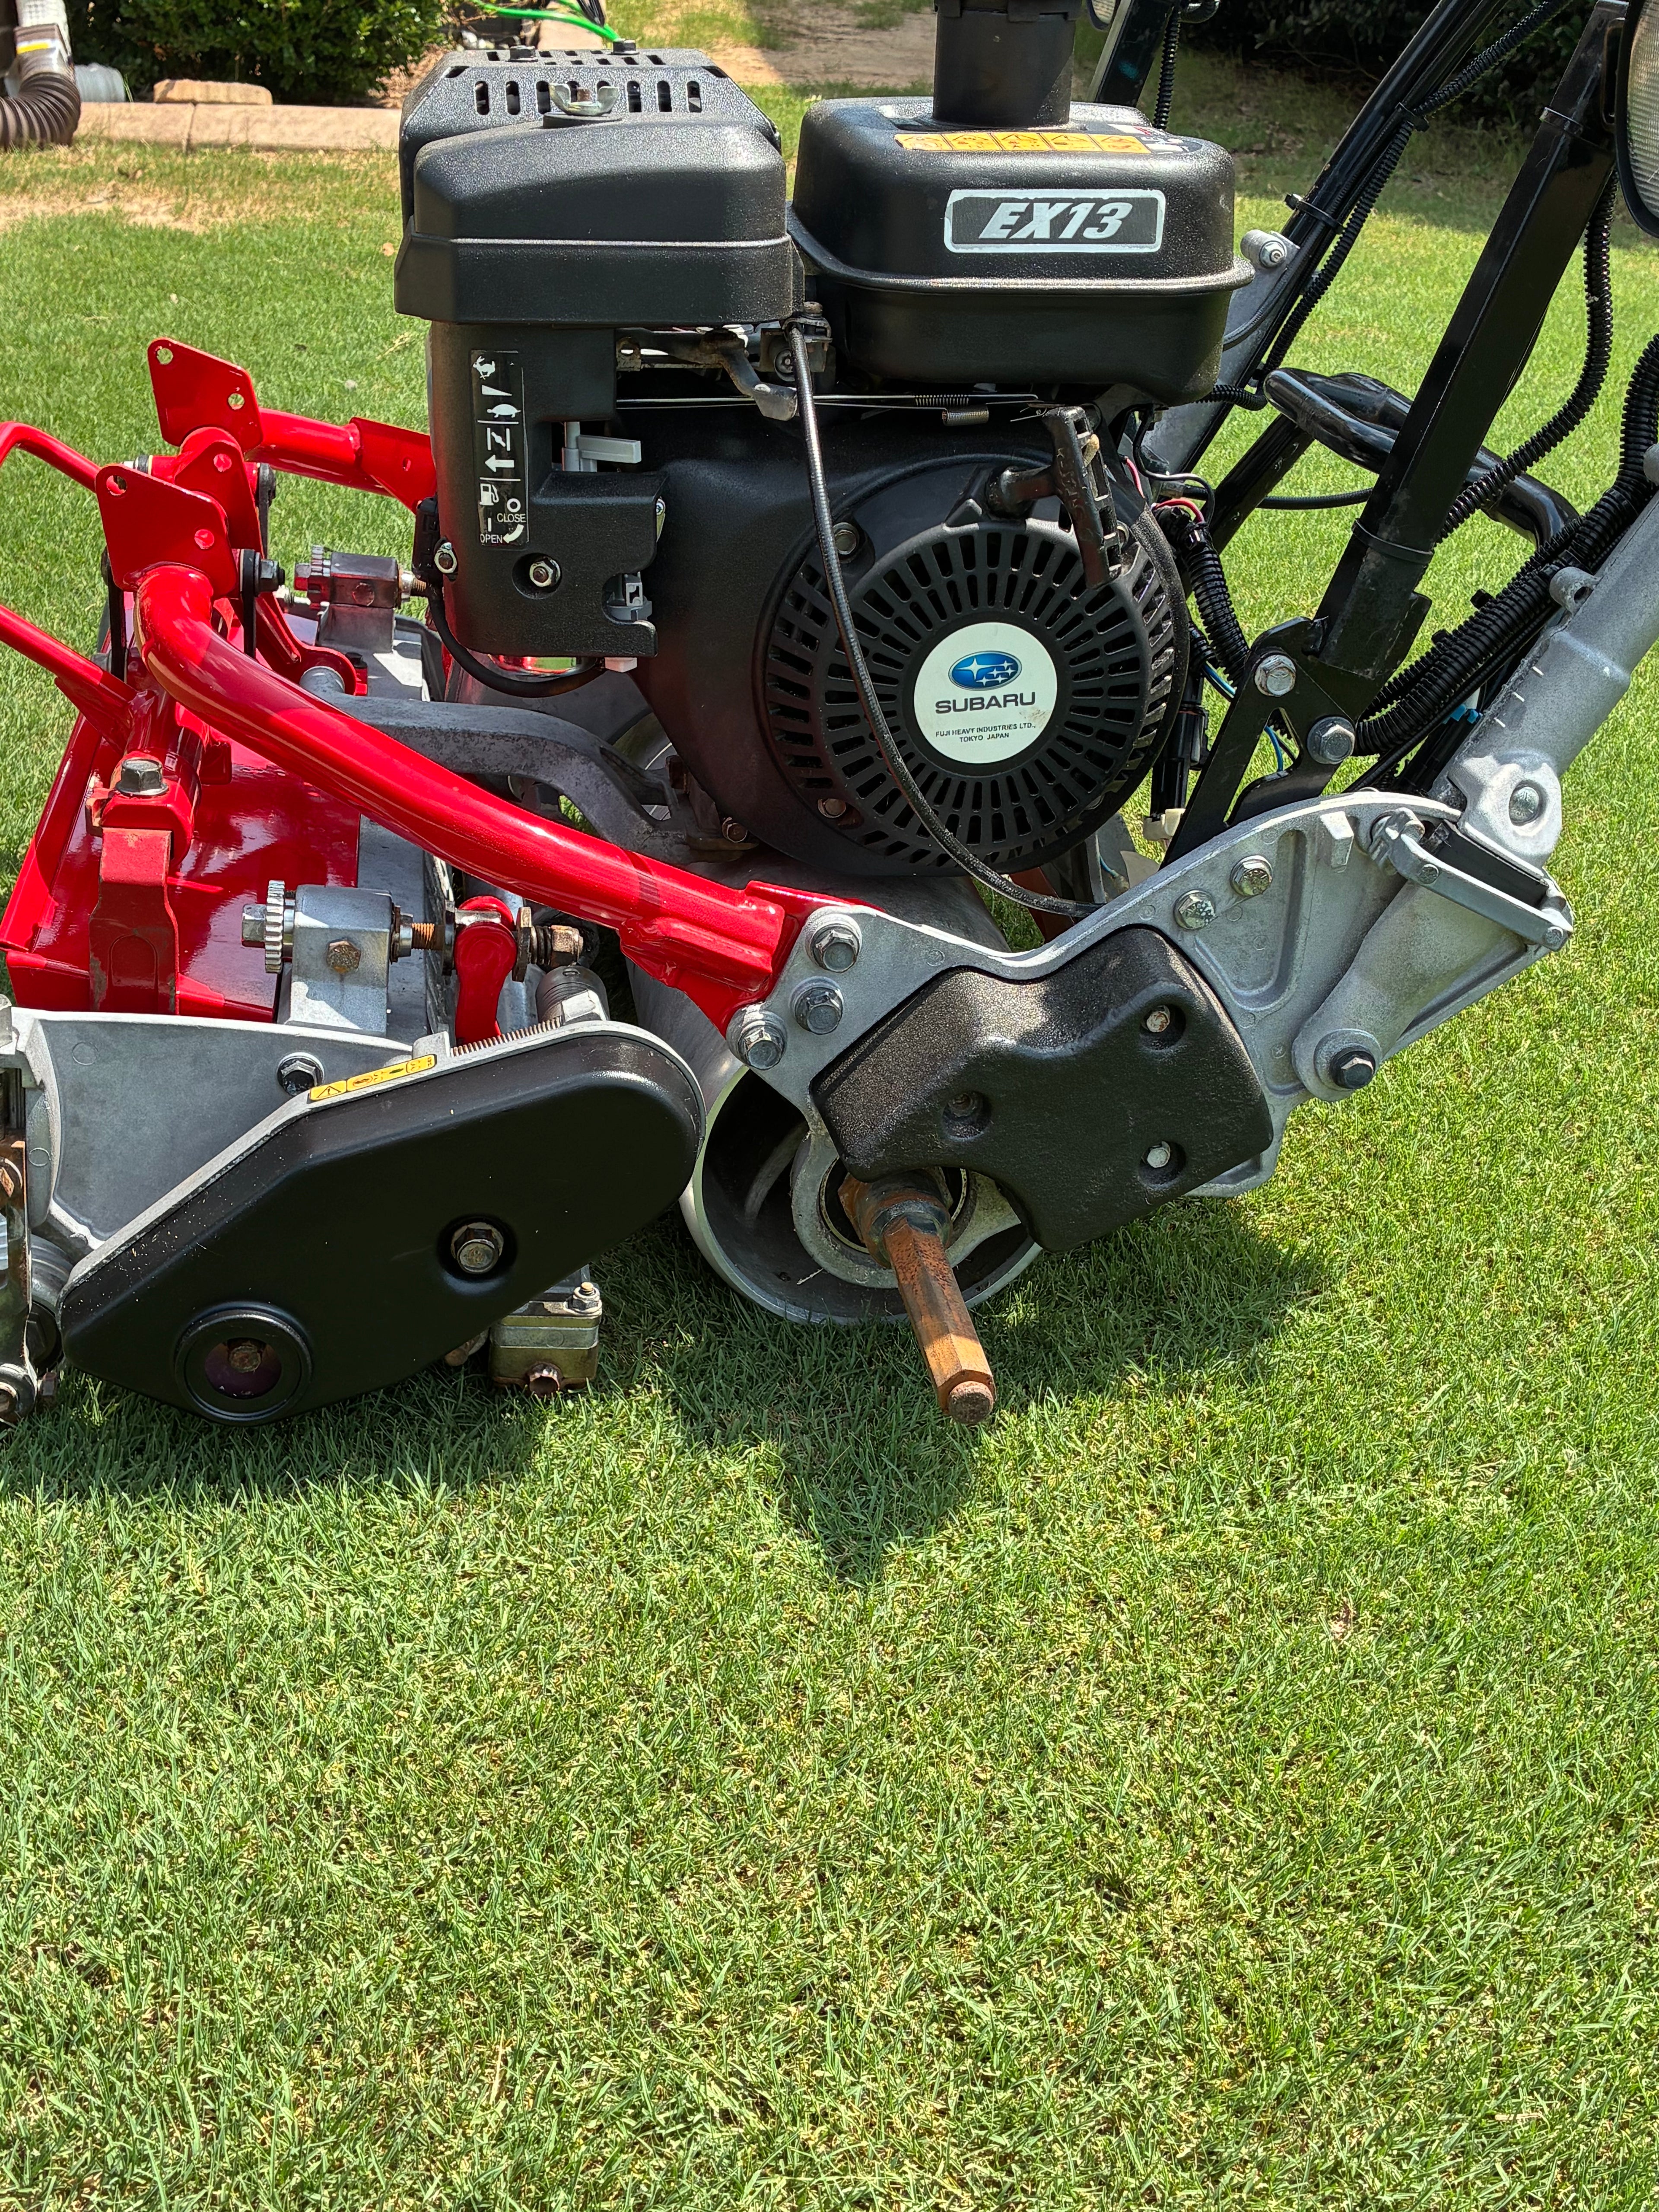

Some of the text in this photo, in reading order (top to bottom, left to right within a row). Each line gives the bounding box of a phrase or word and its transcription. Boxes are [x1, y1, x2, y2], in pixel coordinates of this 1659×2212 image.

[978, 202, 1133, 239] EX13
[497, 513, 526, 523] CLOSE
[480, 534, 503, 543] OPEN
[935, 692, 1036, 714] SUBARU
[976, 724, 1017, 733] INDUSTRIES
